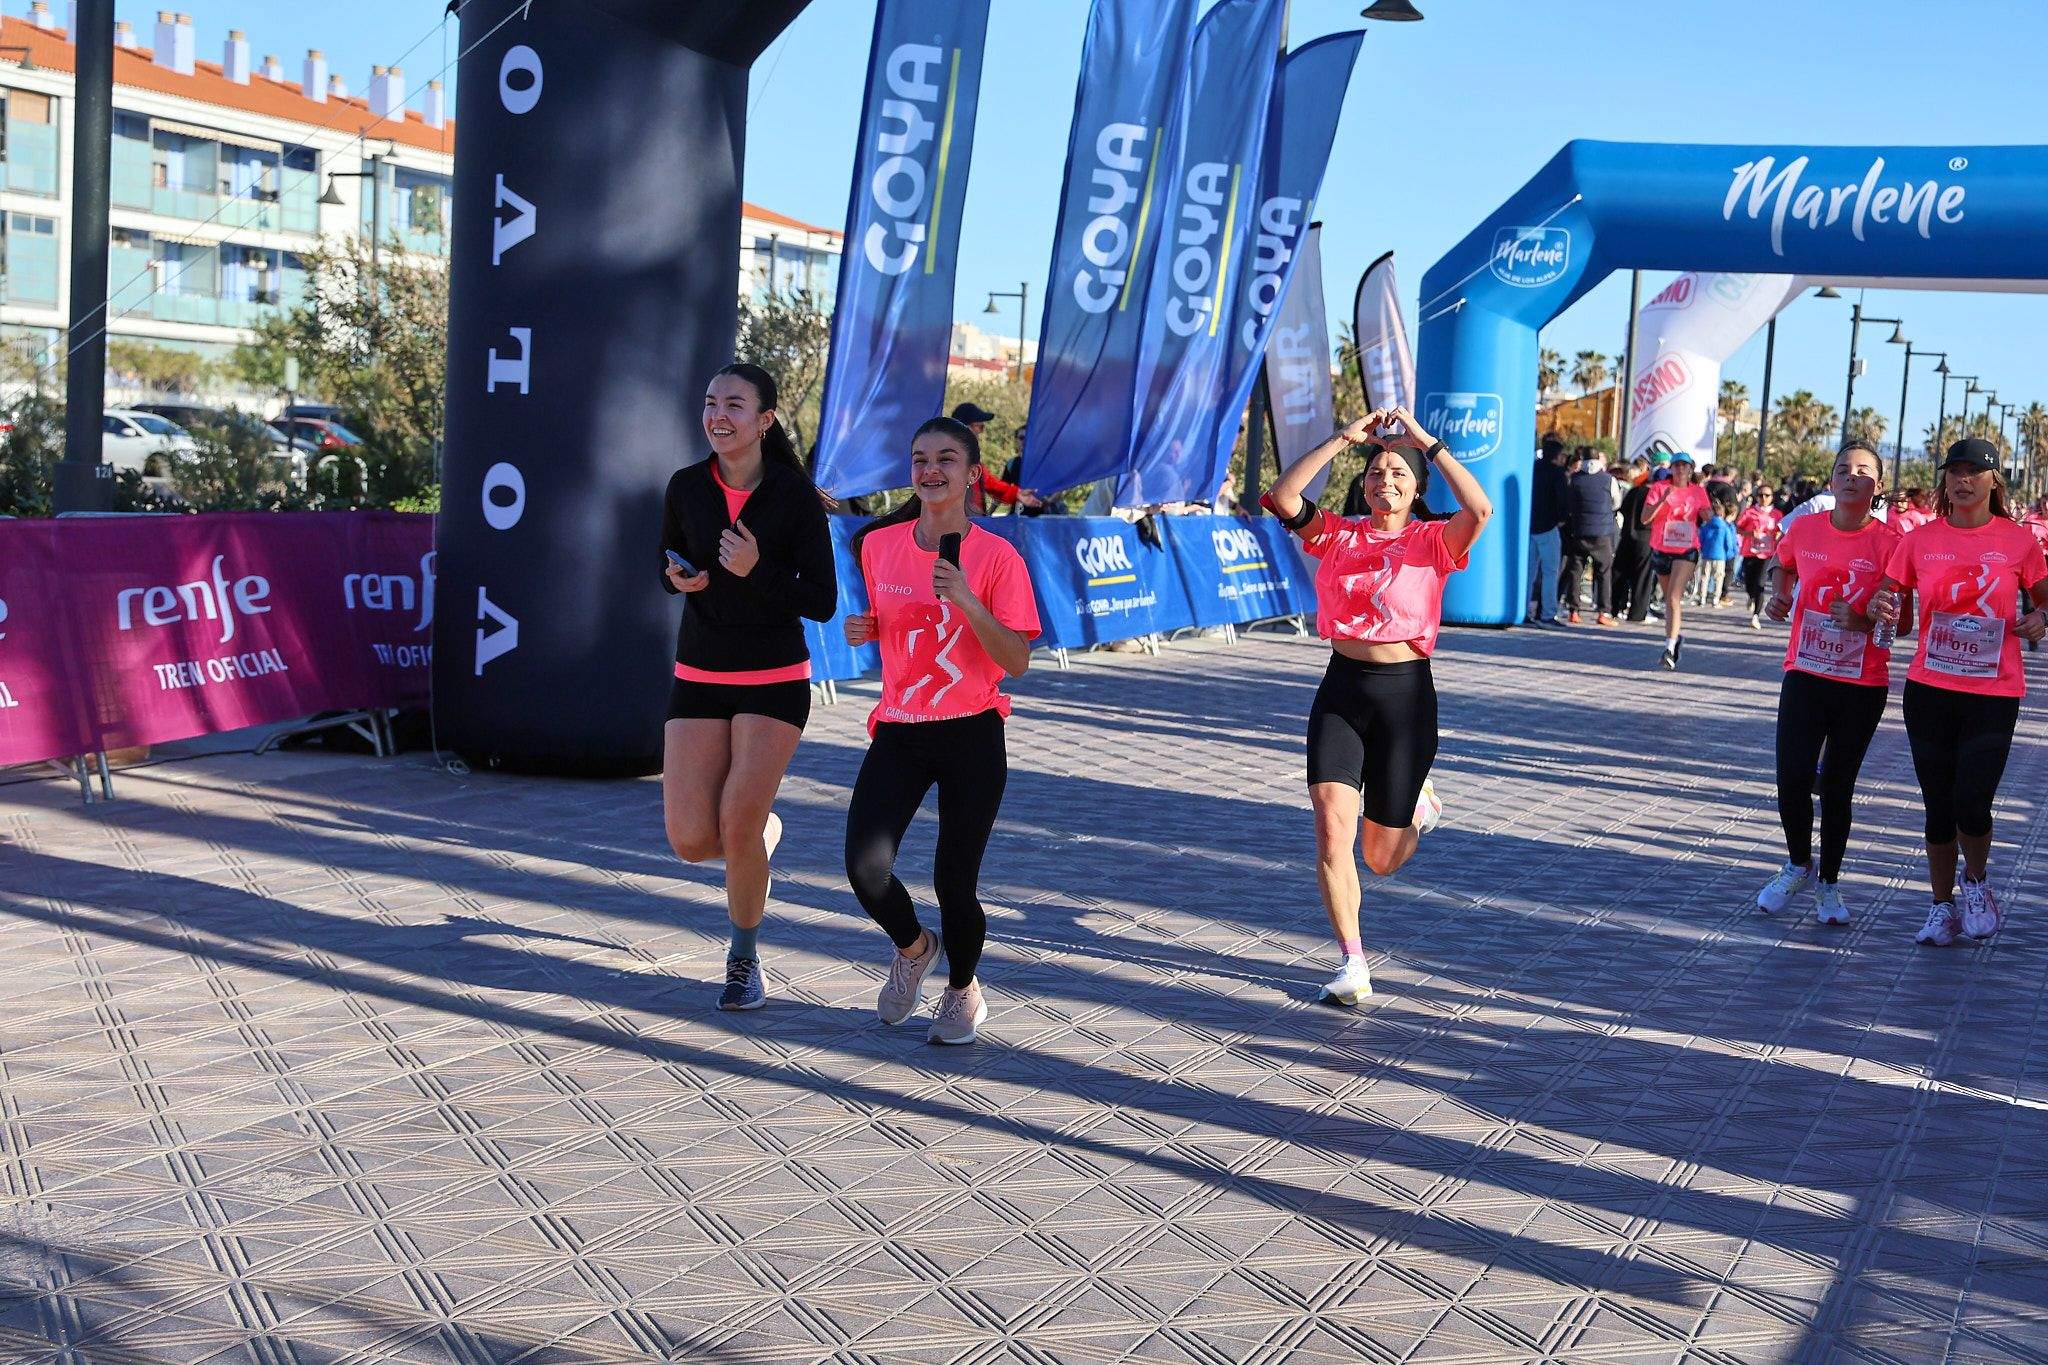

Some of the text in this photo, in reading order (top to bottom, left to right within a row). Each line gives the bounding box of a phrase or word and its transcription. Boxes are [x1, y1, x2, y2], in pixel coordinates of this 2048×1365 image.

[864, 43, 942, 276] GOYA
[1073, 122, 1148, 314] GOYA
[1722, 155, 1967, 257] Marlene
[1166, 161, 1229, 337] GOYA
[1496, 239, 1564, 270] Marlene
[475, 44, 544, 676] VOLVO
[1428, 408, 1497, 440] Marlene
[117, 554, 272, 644] renfe
[877, 582, 913, 596] OYSHO
[153, 648, 288, 690] TREN OFICIAL
[1819, 640, 1844, 653] 016
[1952, 640, 1979, 654] 016
